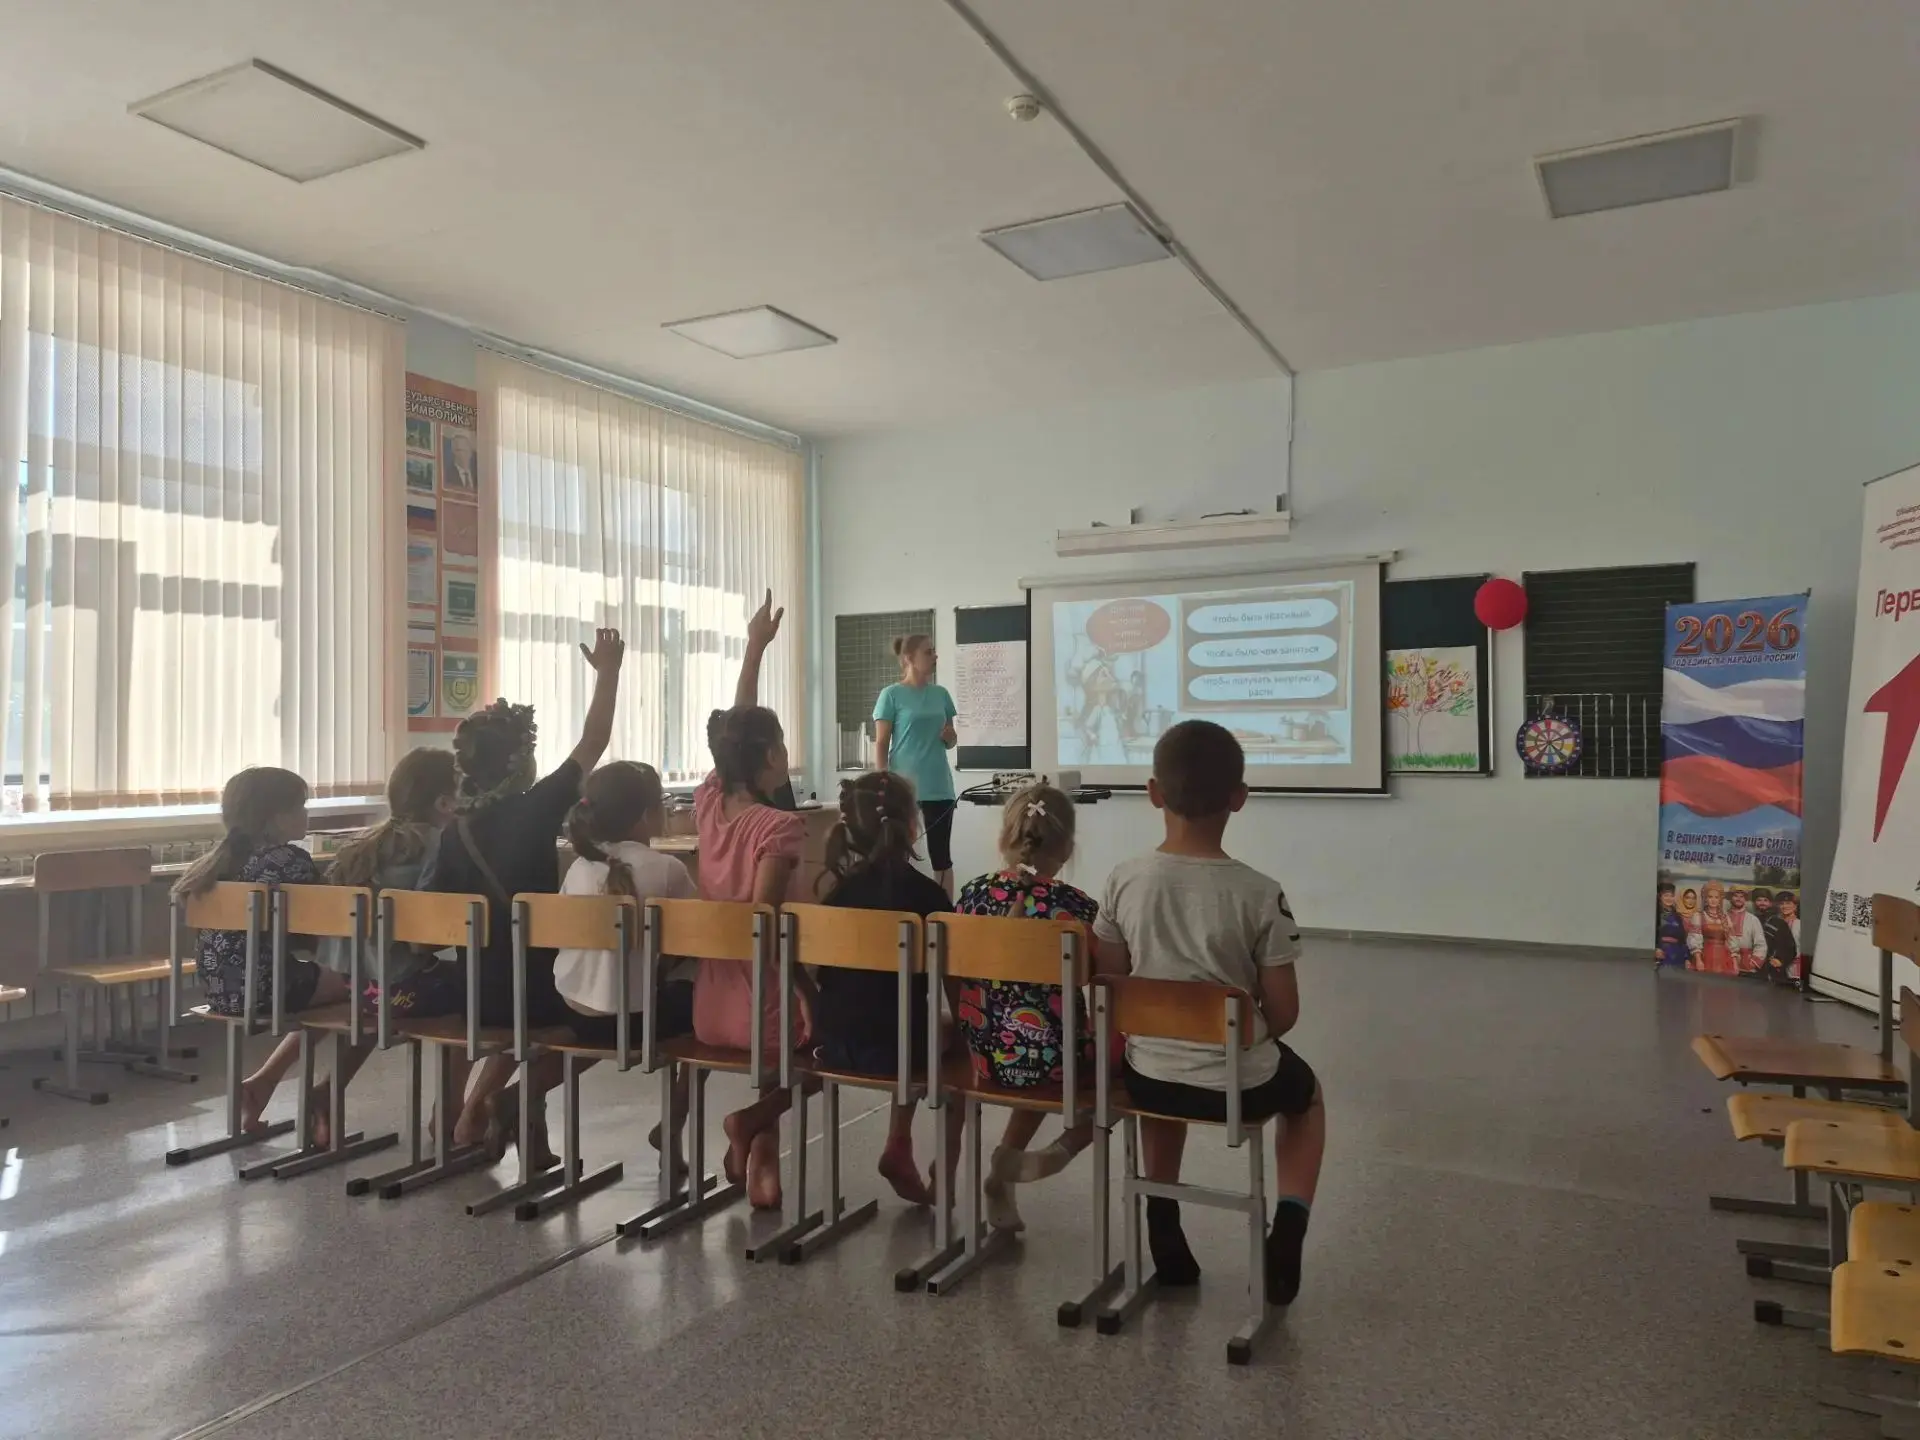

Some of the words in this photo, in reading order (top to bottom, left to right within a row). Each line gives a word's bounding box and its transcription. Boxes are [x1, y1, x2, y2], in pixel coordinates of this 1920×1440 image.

[1674, 607, 1799, 656] 2026
[1727, 653, 1763, 665] НАРОДОВ
[1764, 650, 1800, 663] РОССИИ!
[1667, 829, 1675, 843] В
[1676, 832, 1725, 847] единстве
[1735, 835, 1763, 849] наша
[1664, 849, 1671, 860] в
[1673, 850, 1715, 864] сердцах
[1726, 853, 1751, 866] одна
[1753, 854, 1797, 869] Россия!
